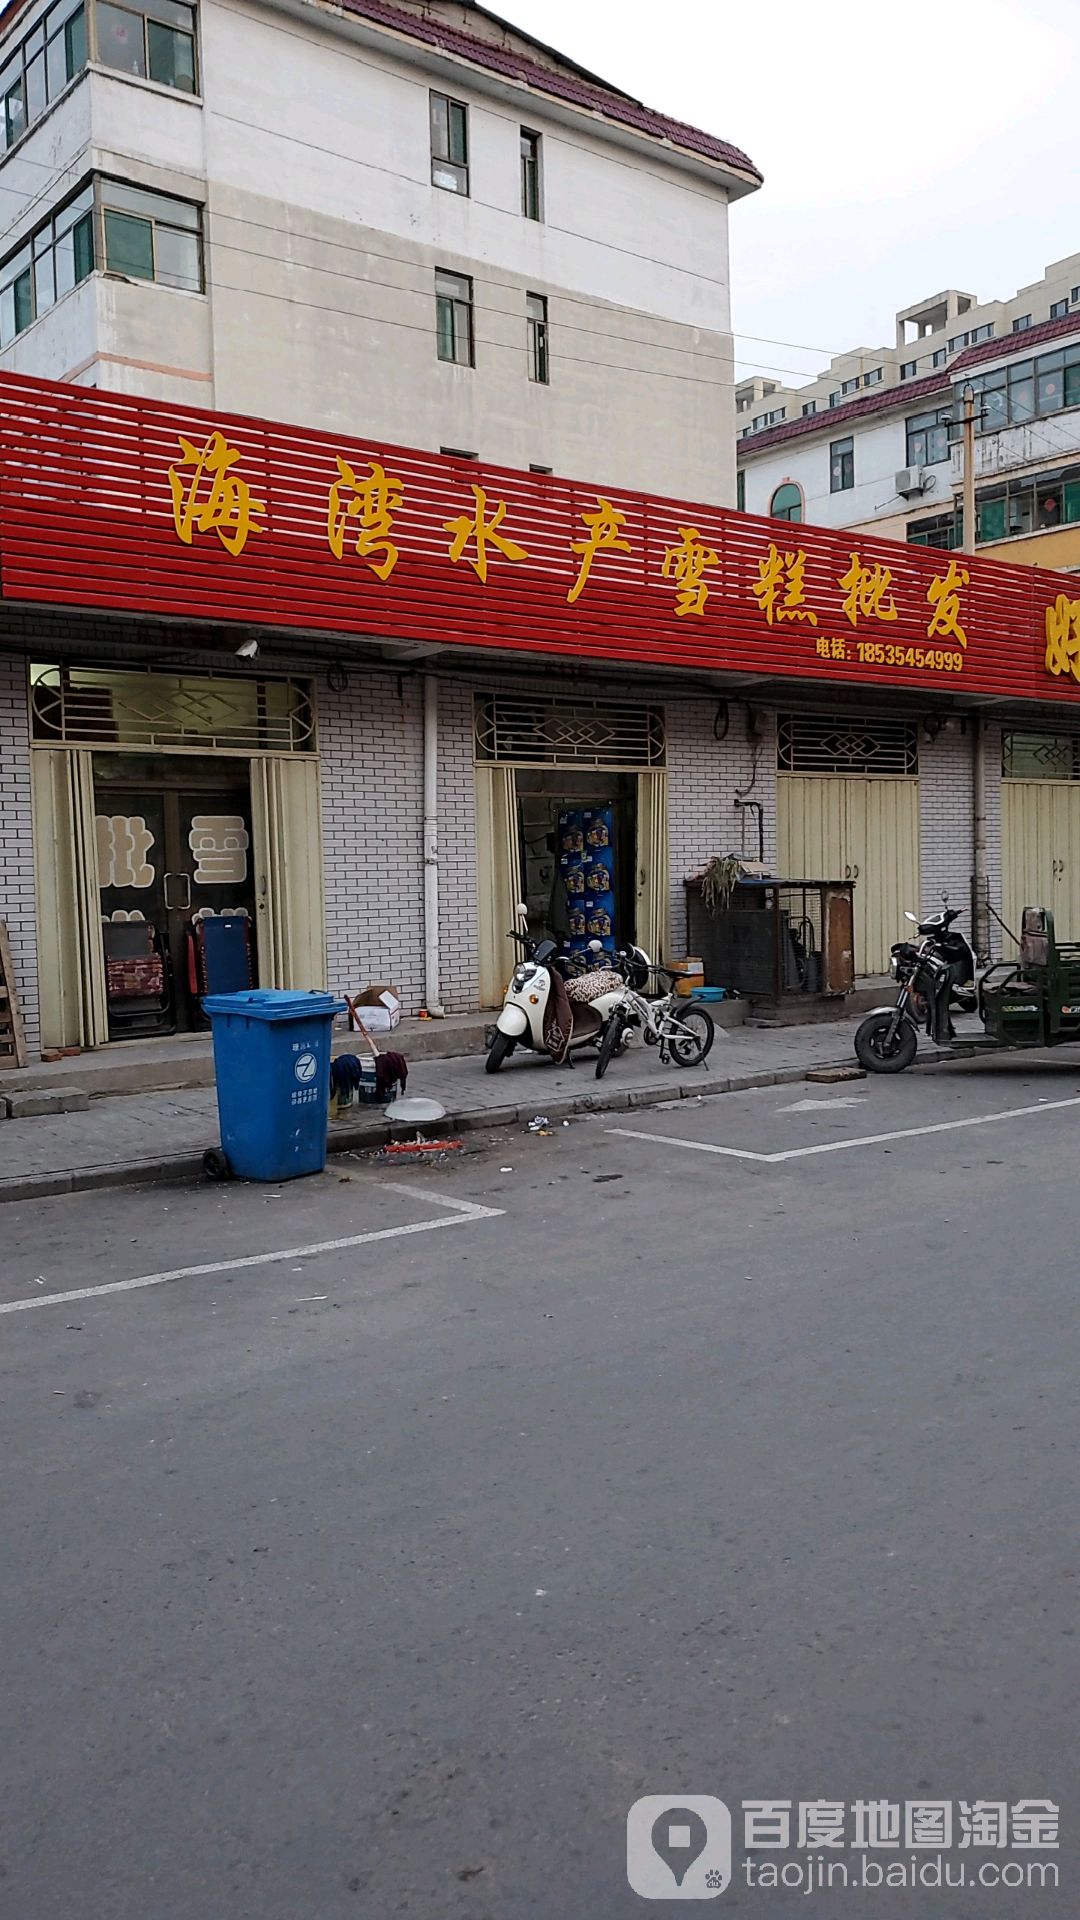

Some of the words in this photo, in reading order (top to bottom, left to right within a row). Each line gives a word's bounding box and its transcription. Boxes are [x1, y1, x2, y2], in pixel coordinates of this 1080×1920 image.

[168, 431, 969, 649] 海湾水产雪糕批发
